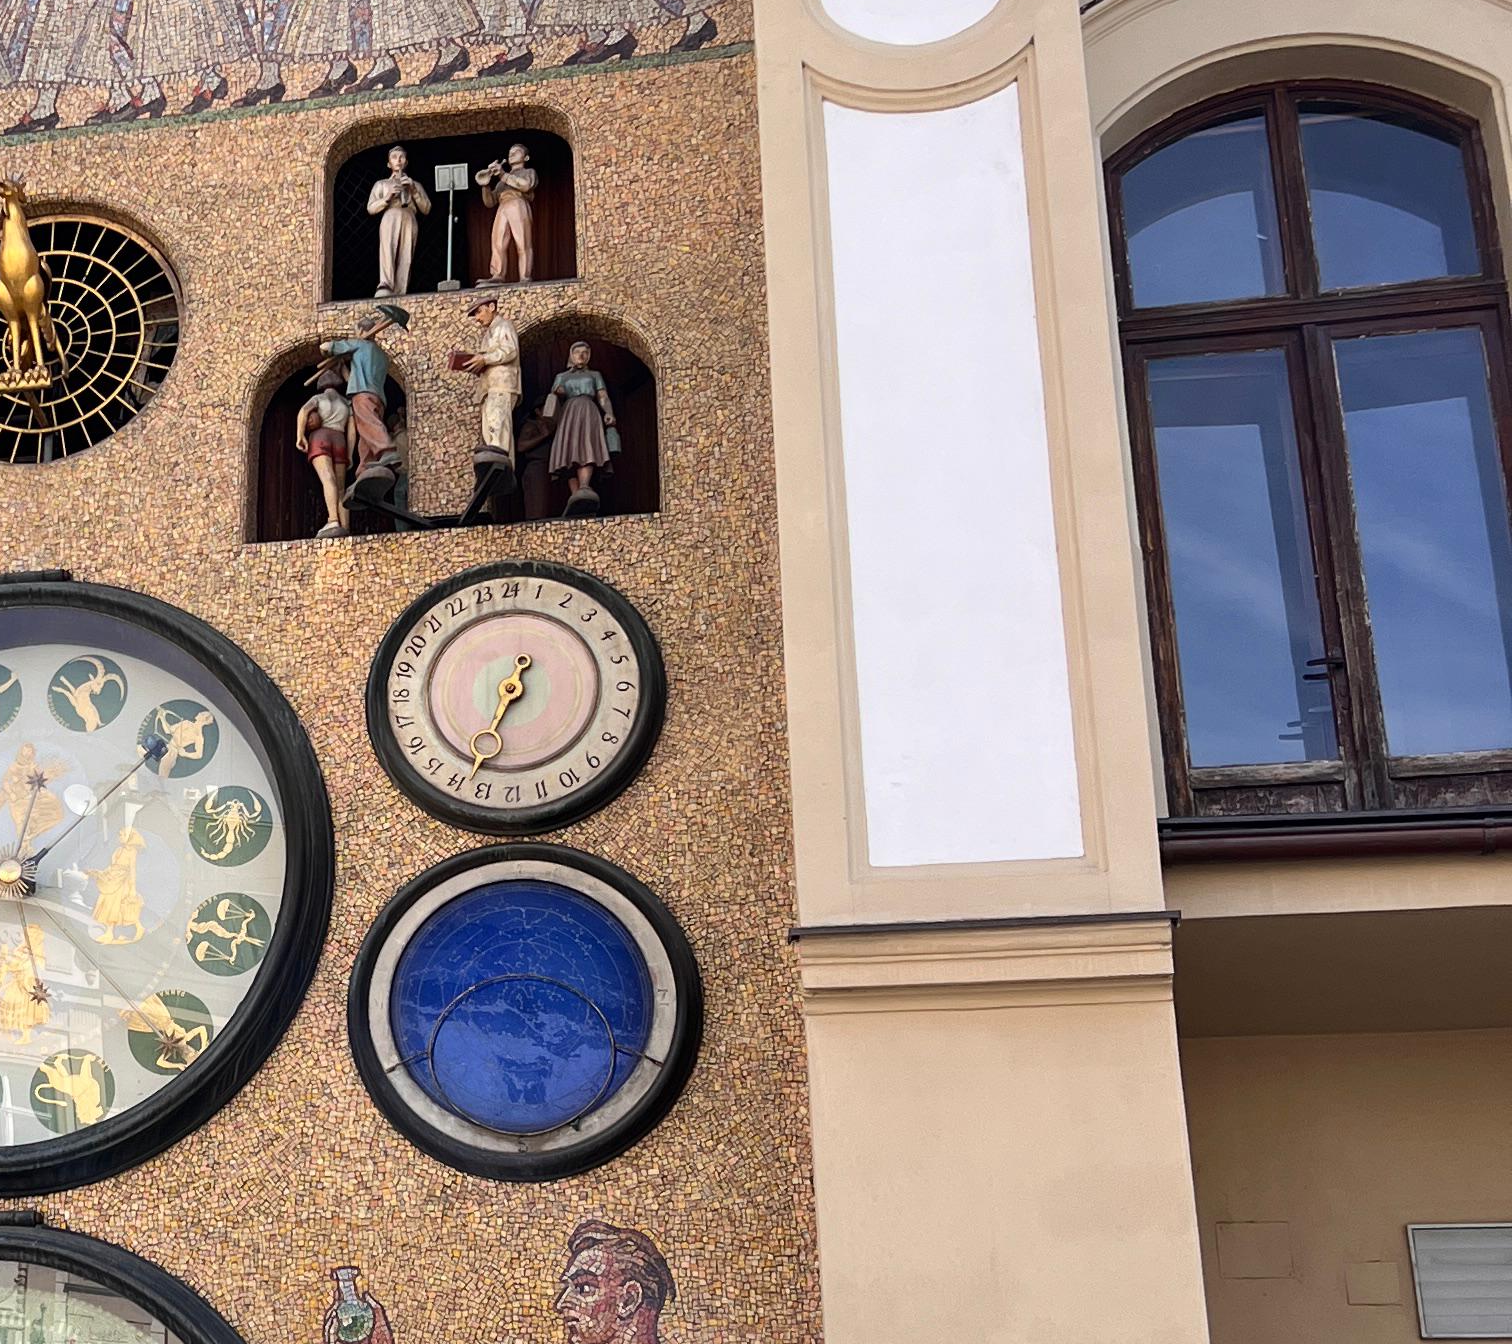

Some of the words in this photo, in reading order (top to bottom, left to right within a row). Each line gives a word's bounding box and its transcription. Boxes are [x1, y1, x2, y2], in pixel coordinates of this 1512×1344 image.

[473, 587, 494, 604] 23
[501, 583, 521, 598] 24
[535, 585, 543, 599] 1
[444, 598, 467, 617] 22
[558, 593, 573, 608] 2
[581, 608, 598, 623] 3
[424, 615, 443, 633] 21
[600, 630, 617, 642] 4
[406, 635, 426, 657] 20
[610, 655, 629, 665] 5
[396, 662, 414, 679] 19
[616, 681, 631, 692] 6
[392, 688, 410, 703] 18
[611, 707, 631, 720] 7
[398, 715, 415, 729] 17
[409, 736, 428, 754] 16
[602, 732, 619, 745] 8
[423, 757, 445, 774] 15
[586, 752, 600, 769] 9
[447, 774, 467, 790] 14
[559, 768, 580, 788] 10
[475, 783, 492, 799] 13
[505, 786, 521, 802] 12
[535, 782, 547, 798] 11
